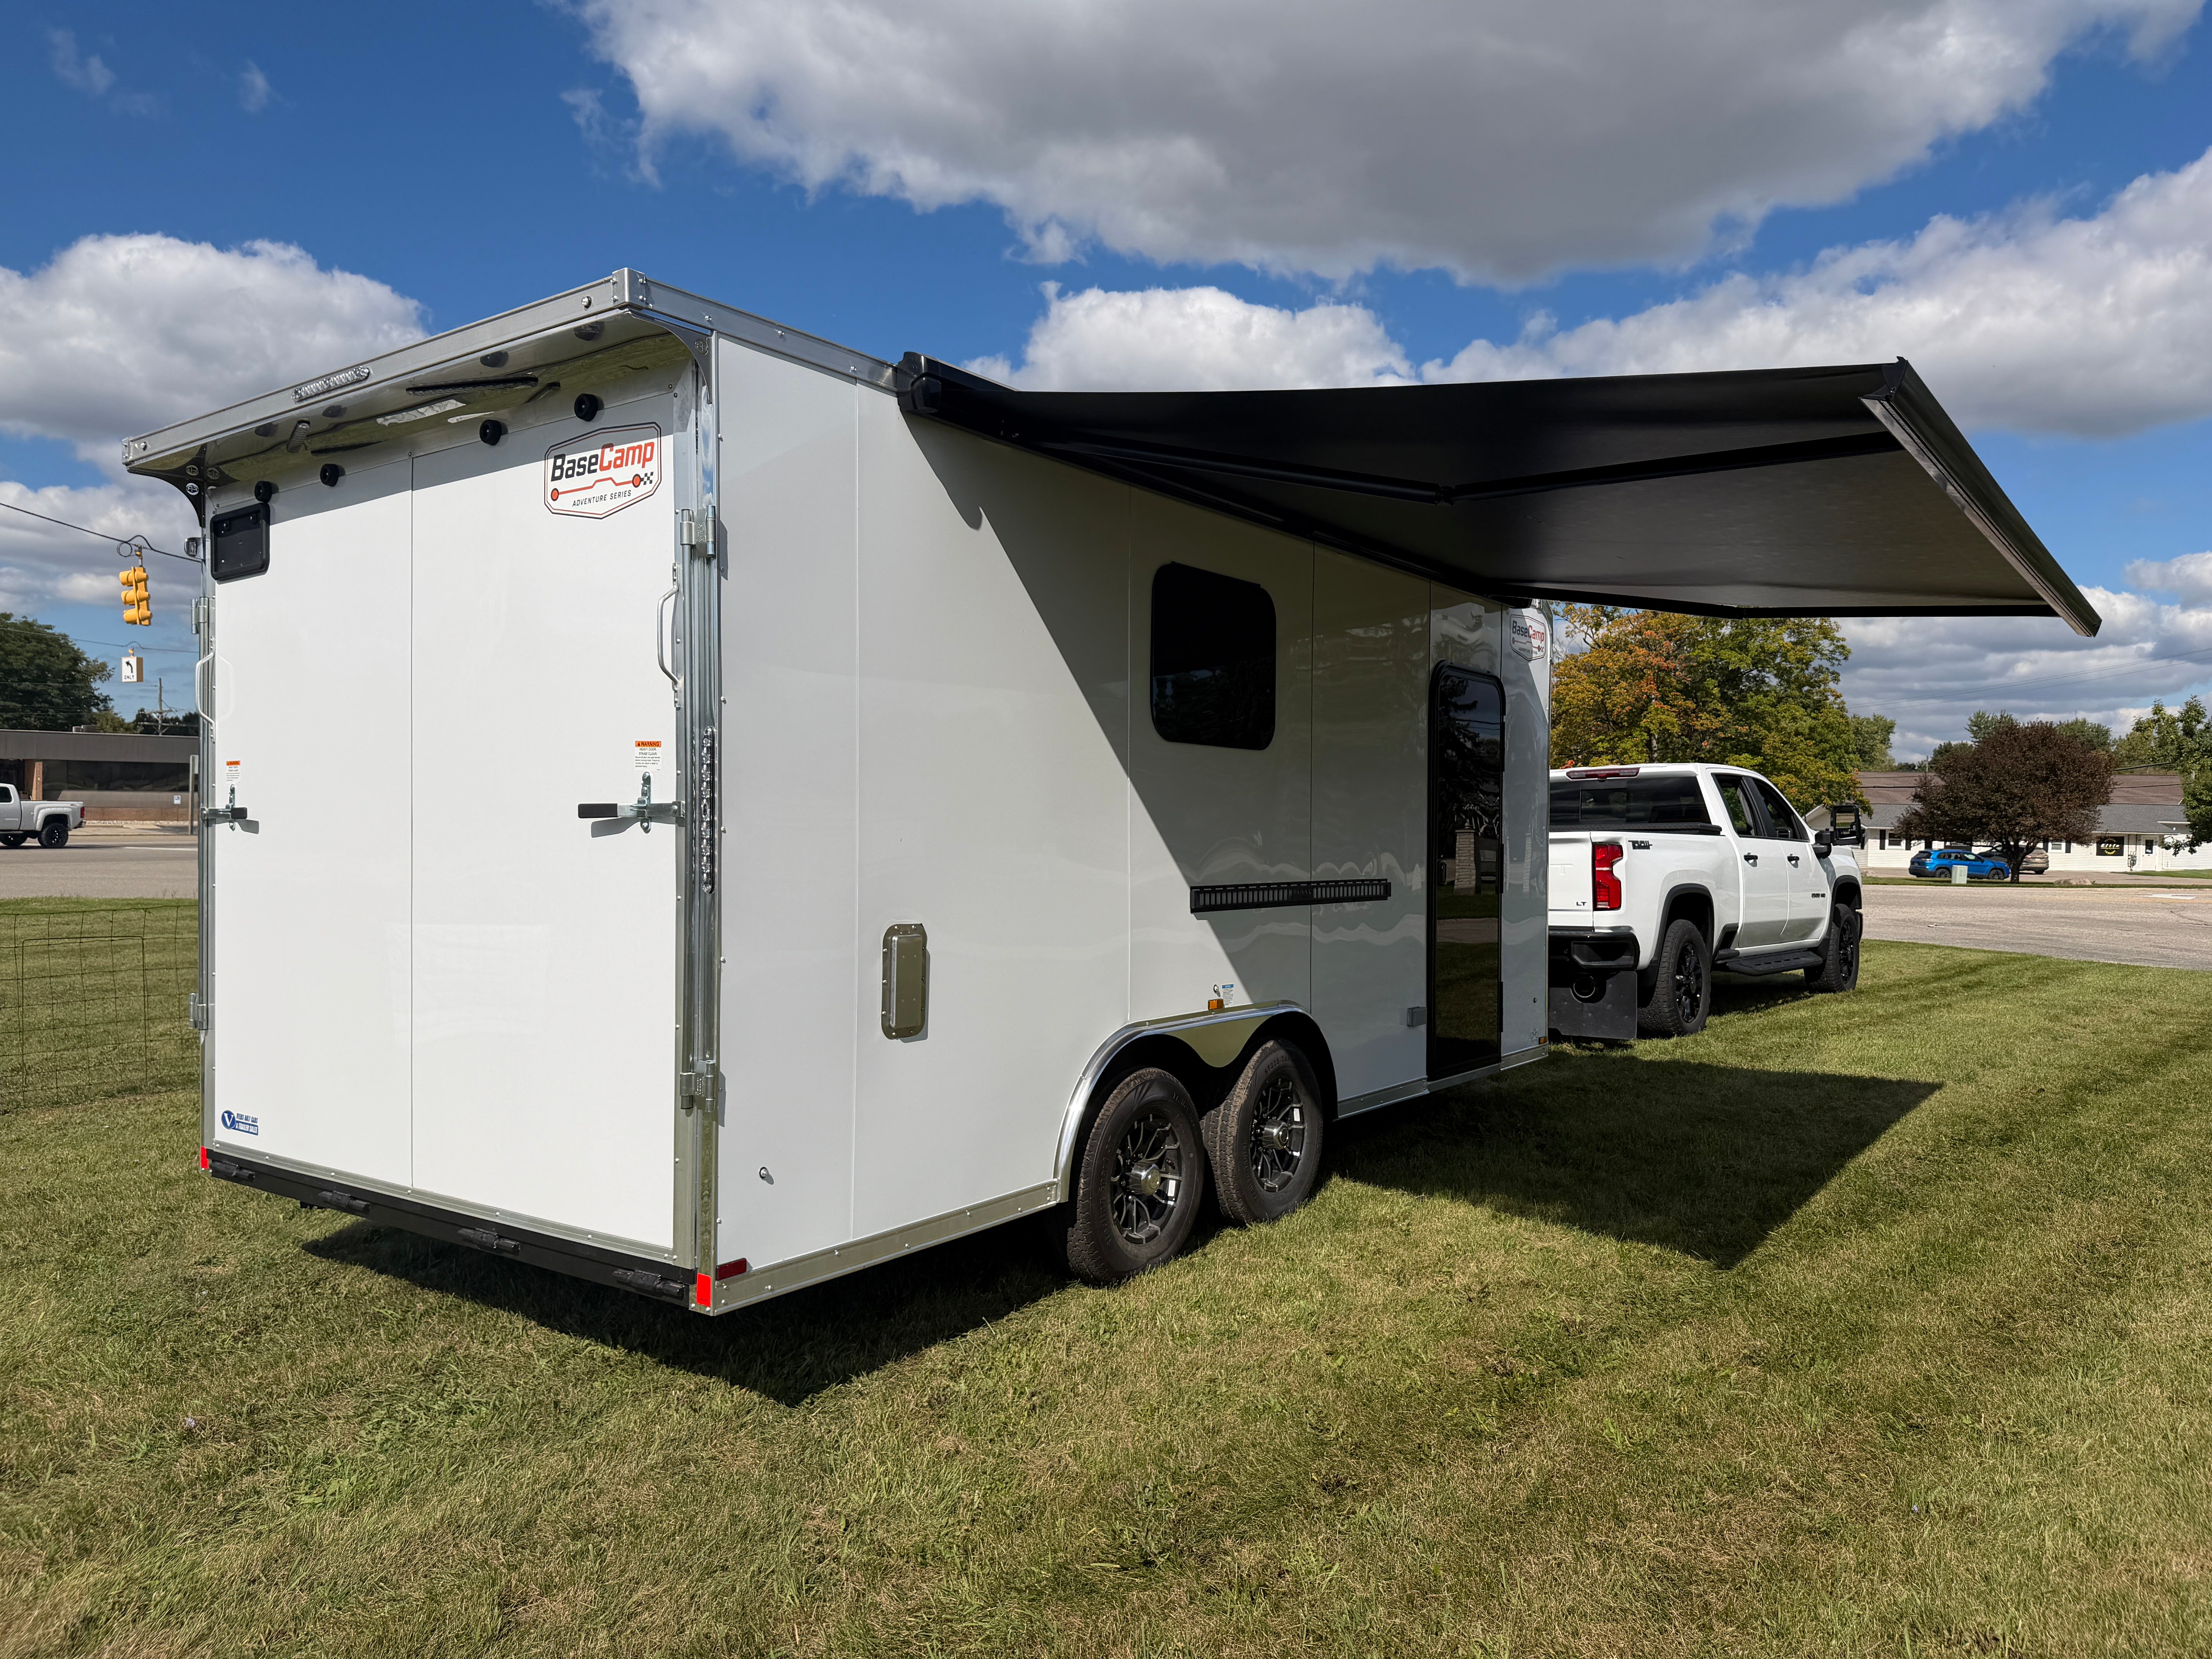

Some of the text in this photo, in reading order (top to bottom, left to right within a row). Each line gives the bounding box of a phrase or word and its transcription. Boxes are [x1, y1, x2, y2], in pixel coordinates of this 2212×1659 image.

[551, 441, 655, 482] BaseCamp
[572, 489, 632, 507] ADVENTURE SERIES
[1512, 620, 1544, 644] BaseCamp
